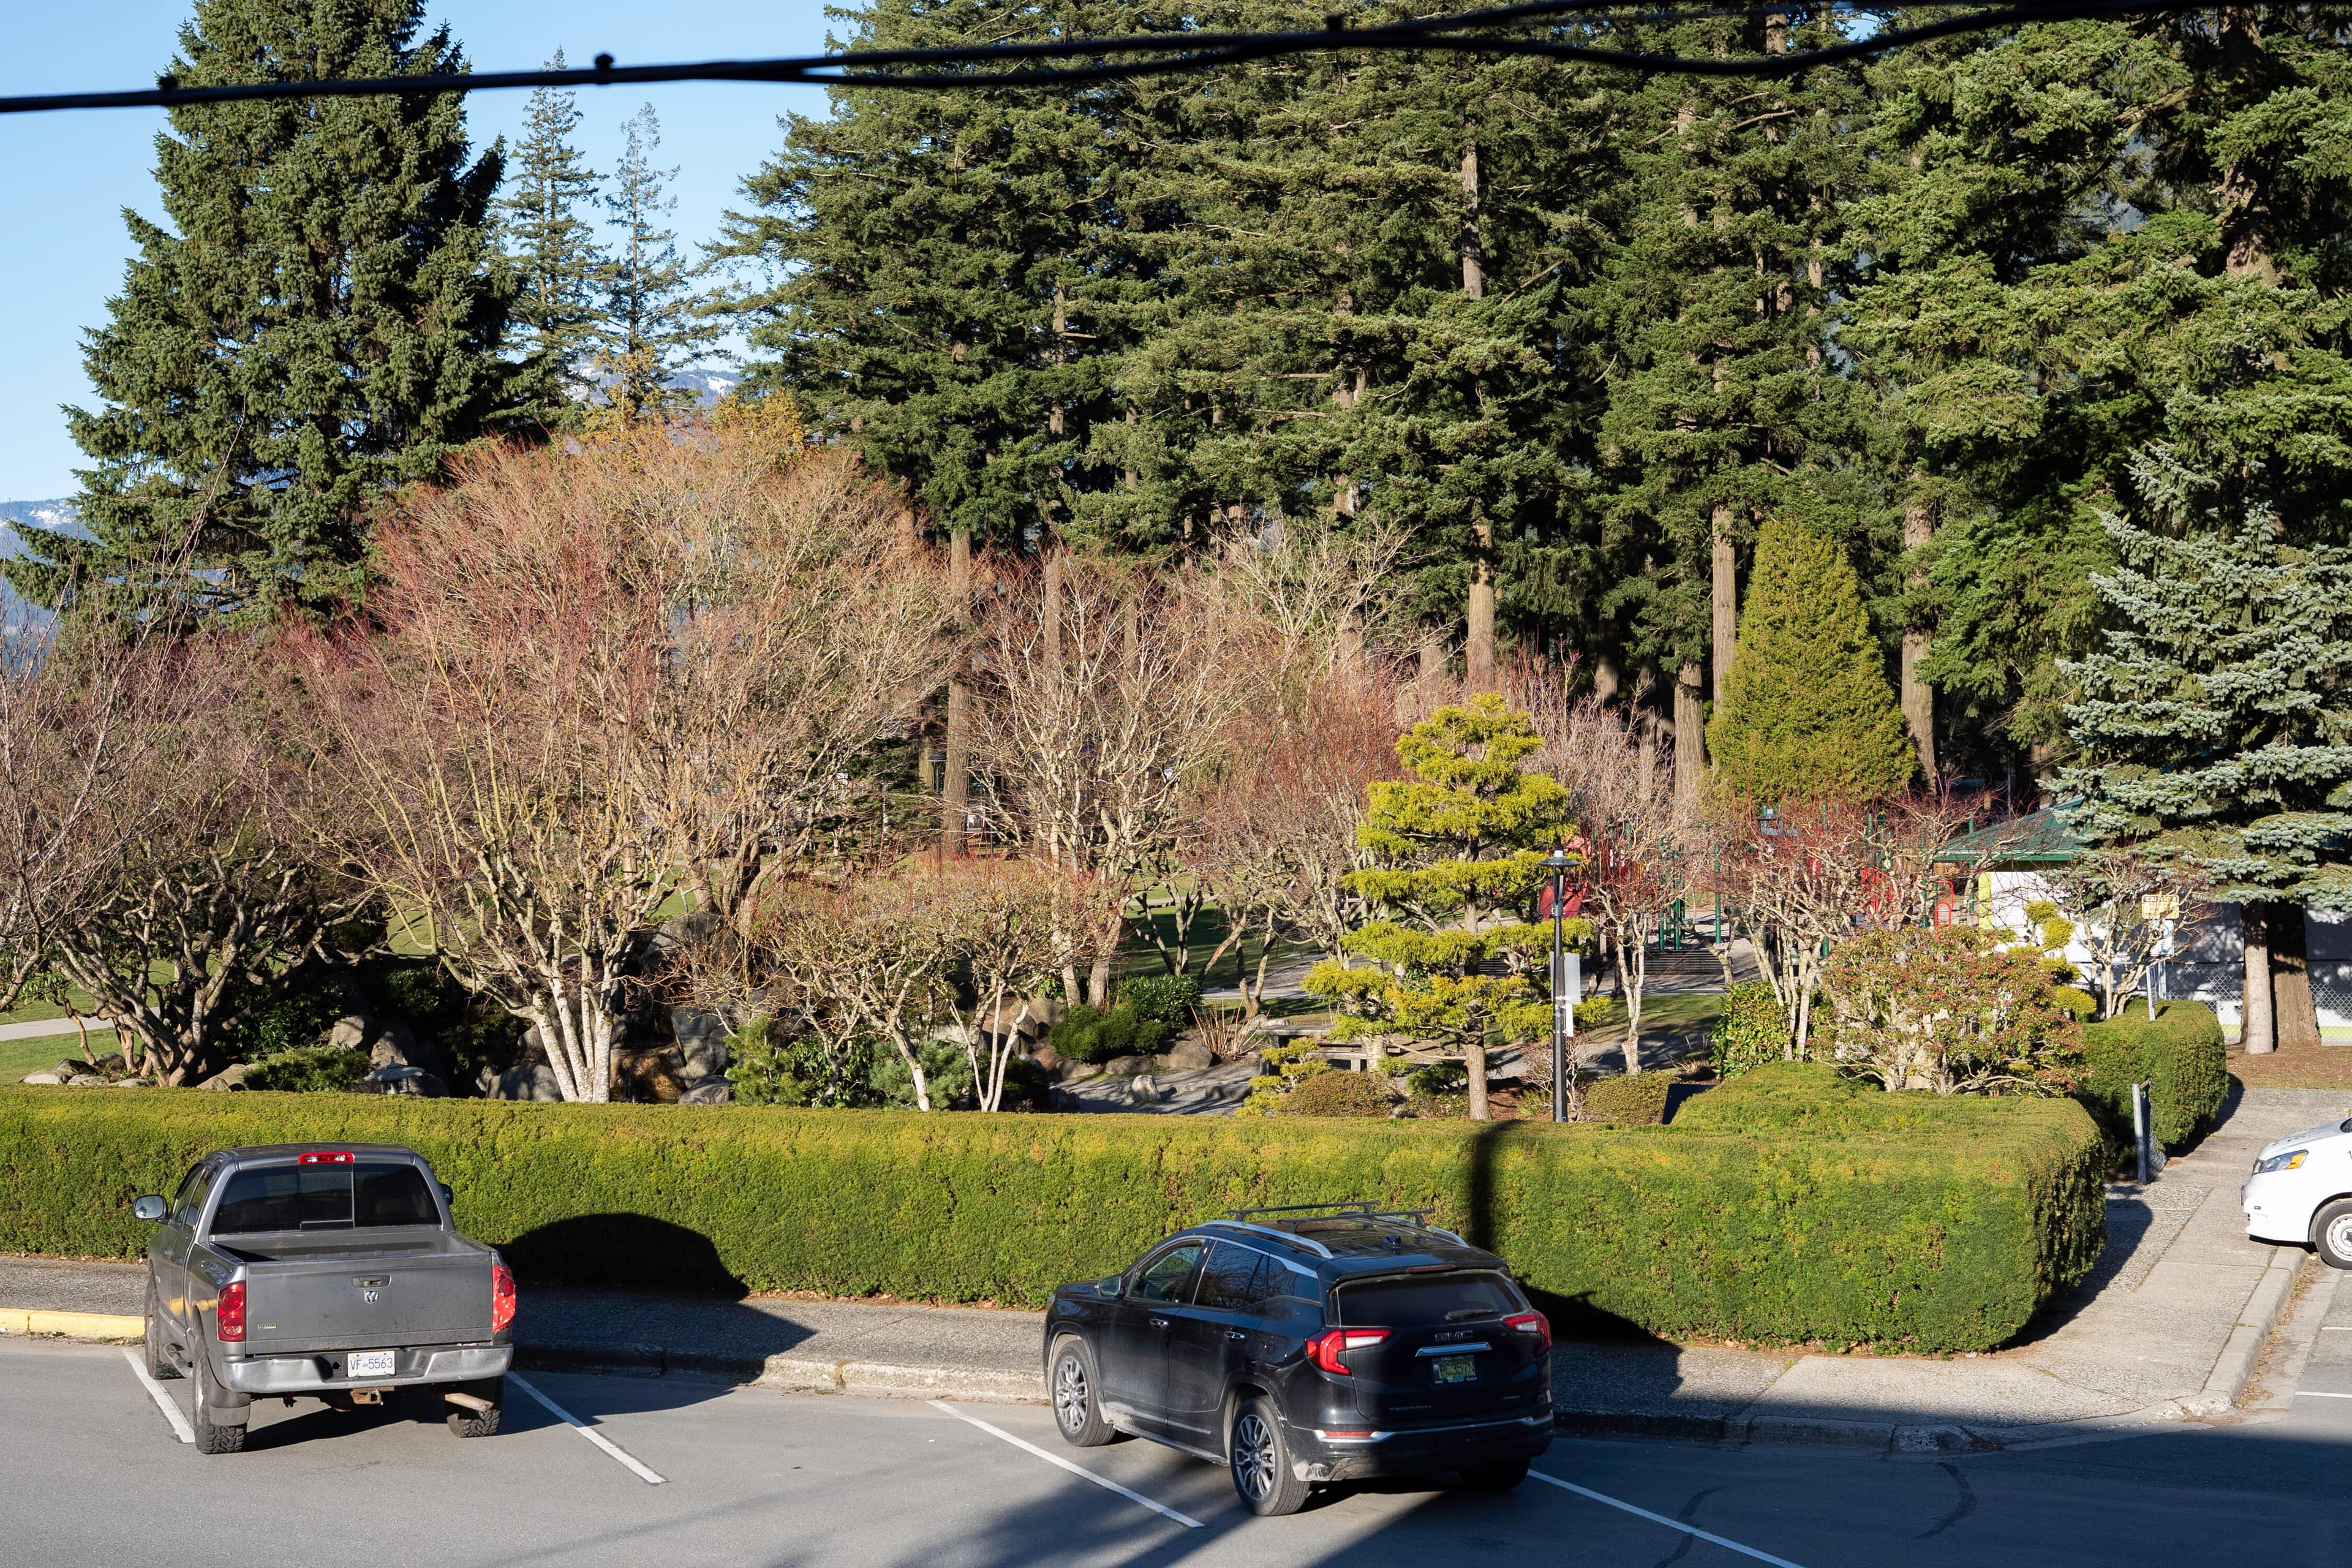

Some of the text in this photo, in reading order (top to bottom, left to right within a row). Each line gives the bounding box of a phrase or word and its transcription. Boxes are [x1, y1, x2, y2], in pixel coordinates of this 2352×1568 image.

[1435, 1330, 1473, 1342] GMC
[350, 1358, 393, 1370] VF 5563
